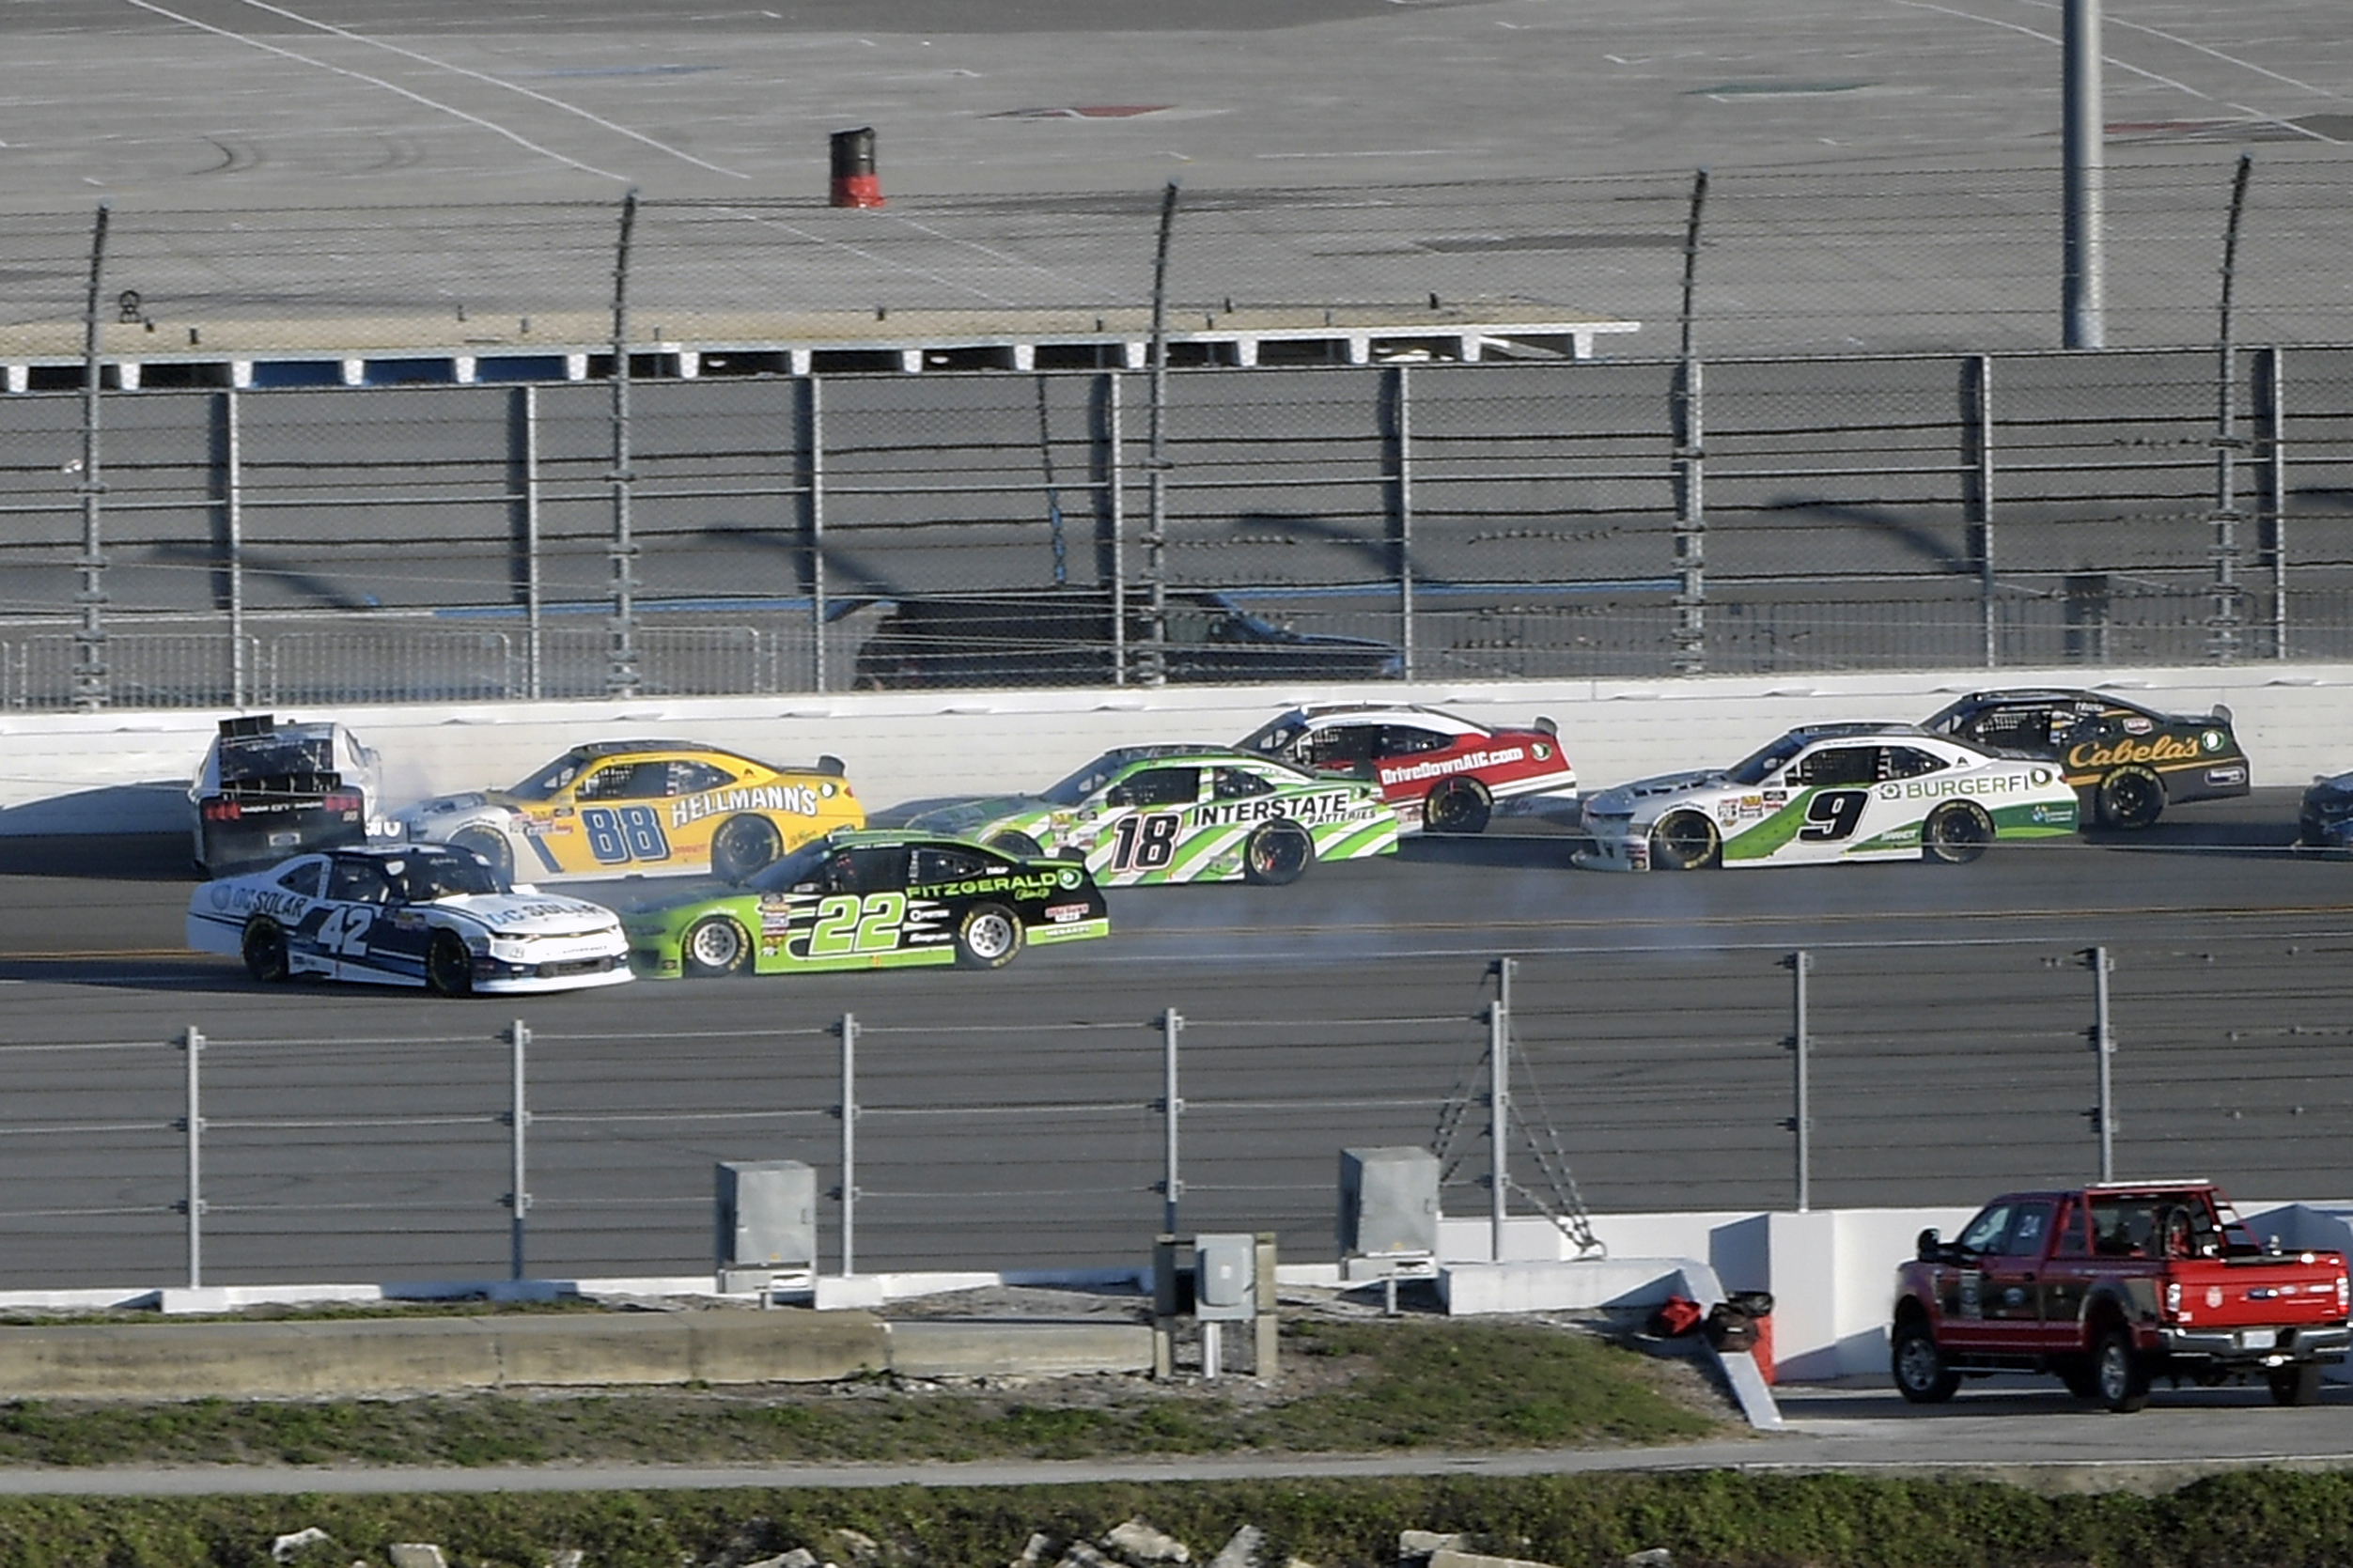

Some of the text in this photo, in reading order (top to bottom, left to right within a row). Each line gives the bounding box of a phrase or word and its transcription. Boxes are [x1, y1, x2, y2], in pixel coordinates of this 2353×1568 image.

[2068, 735, 2201, 768] Cabela's
[671, 784, 818, 829] HELLMANN'S
[1906, 775, 2030, 799] BURGERFI
[1192, 793, 1348, 827] INTERSTATE
[1307, 809, 1377, 825] BATTERIES
[1797, 789, 1870, 843] 9
[581, 804, 670, 865] 88
[1111, 811, 1183, 874] 18
[253, 891, 307, 918] SOLAR
[905, 872, 1057, 899] FITZGERALD
[317, 904, 375, 956] 42
[809, 892, 906, 955] 22
